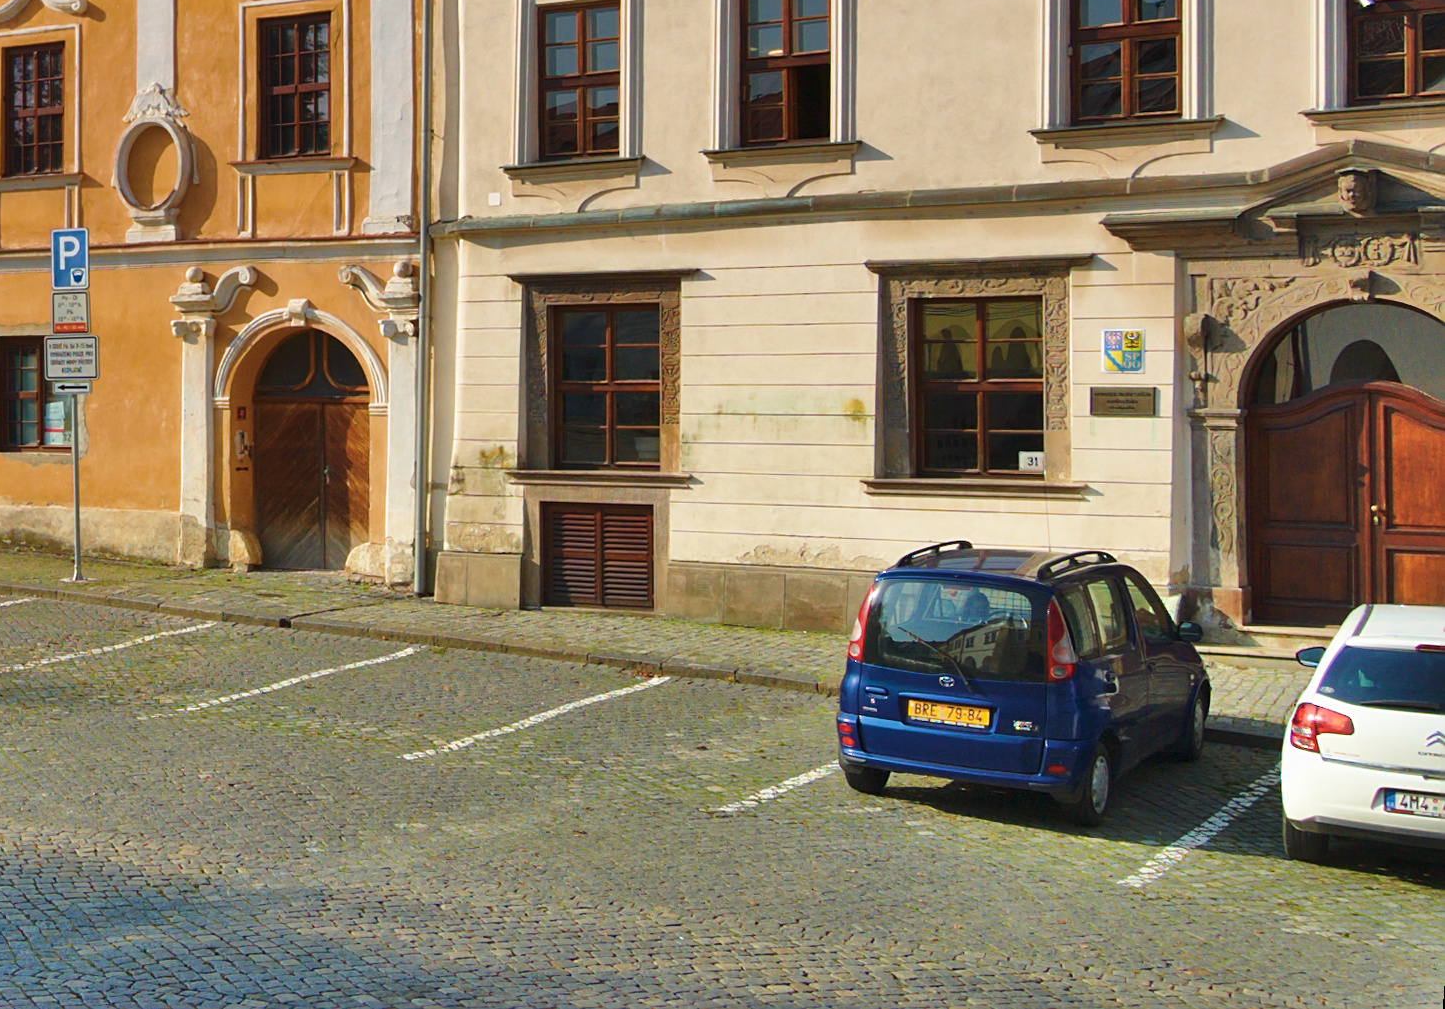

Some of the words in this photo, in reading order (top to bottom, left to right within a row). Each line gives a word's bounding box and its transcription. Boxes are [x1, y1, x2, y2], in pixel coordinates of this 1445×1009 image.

[59, 236, 80, 271] P
[1027, 456, 1039, 467] 31
[914, 702, 938, 717] BRE
